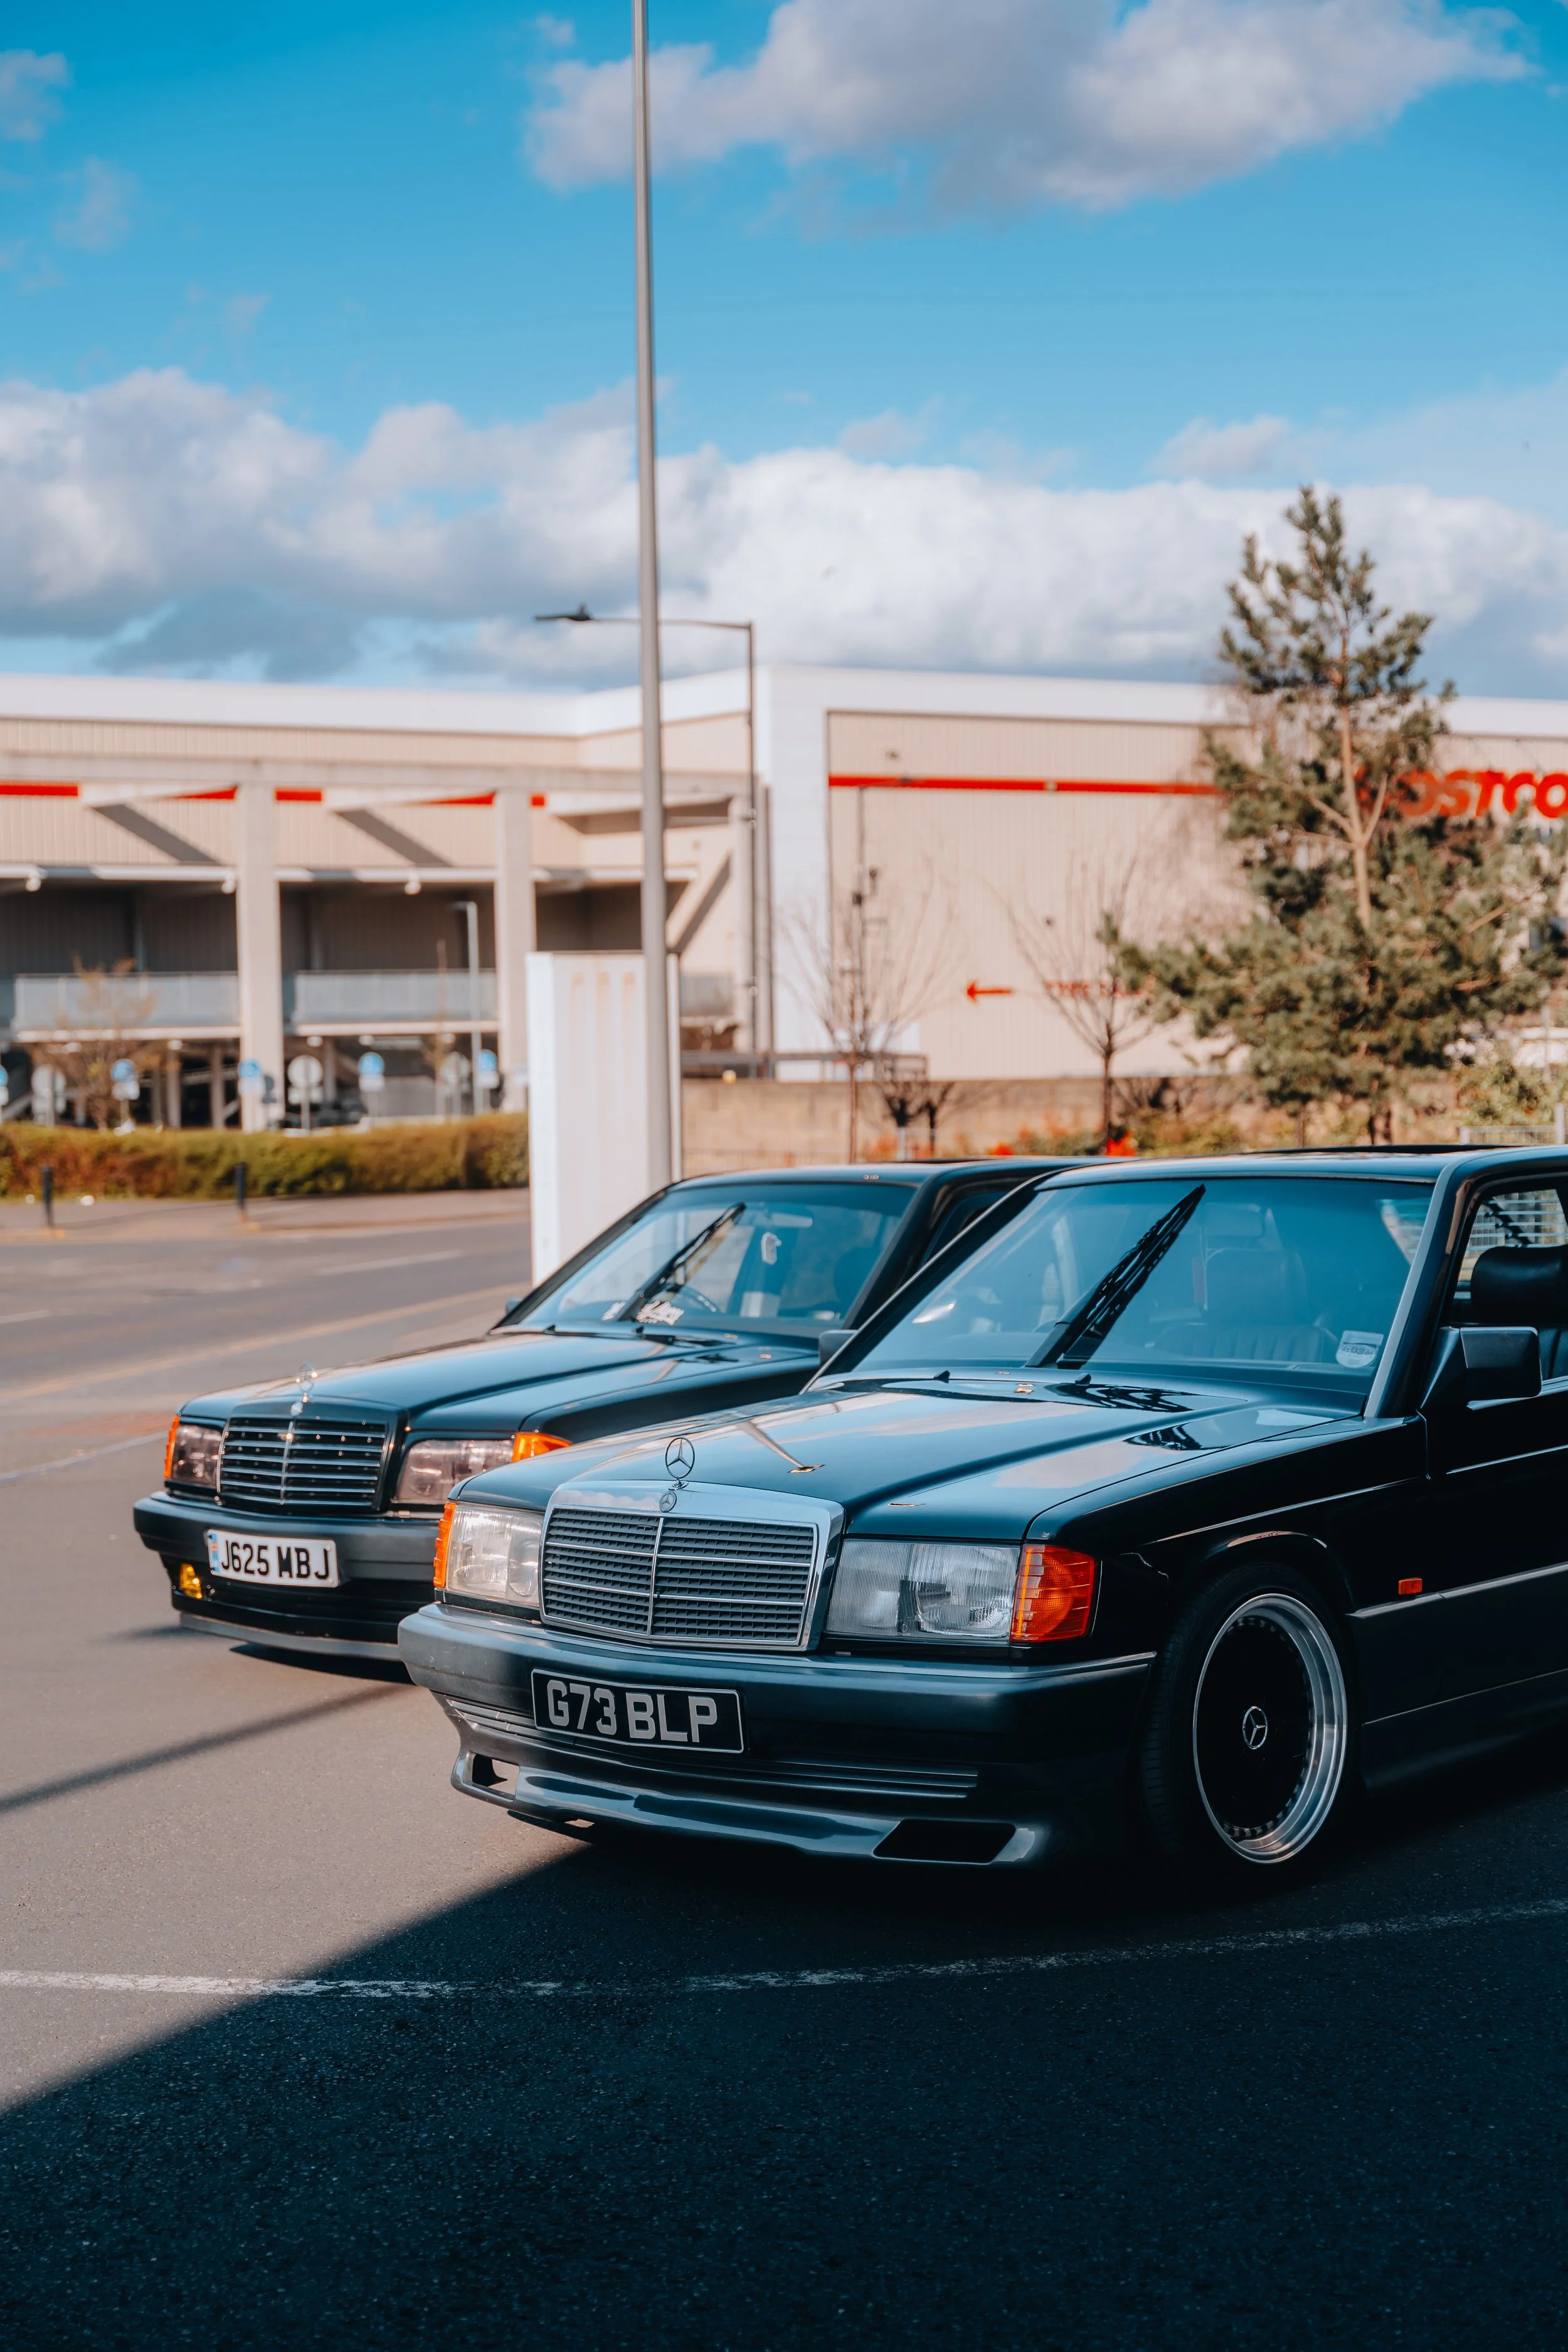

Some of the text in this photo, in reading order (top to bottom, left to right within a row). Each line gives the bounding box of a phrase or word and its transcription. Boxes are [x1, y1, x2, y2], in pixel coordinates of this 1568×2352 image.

[221, 1540, 329, 1579] J625 MBJ
[547, 1679, 718, 1743] G73 BLP
